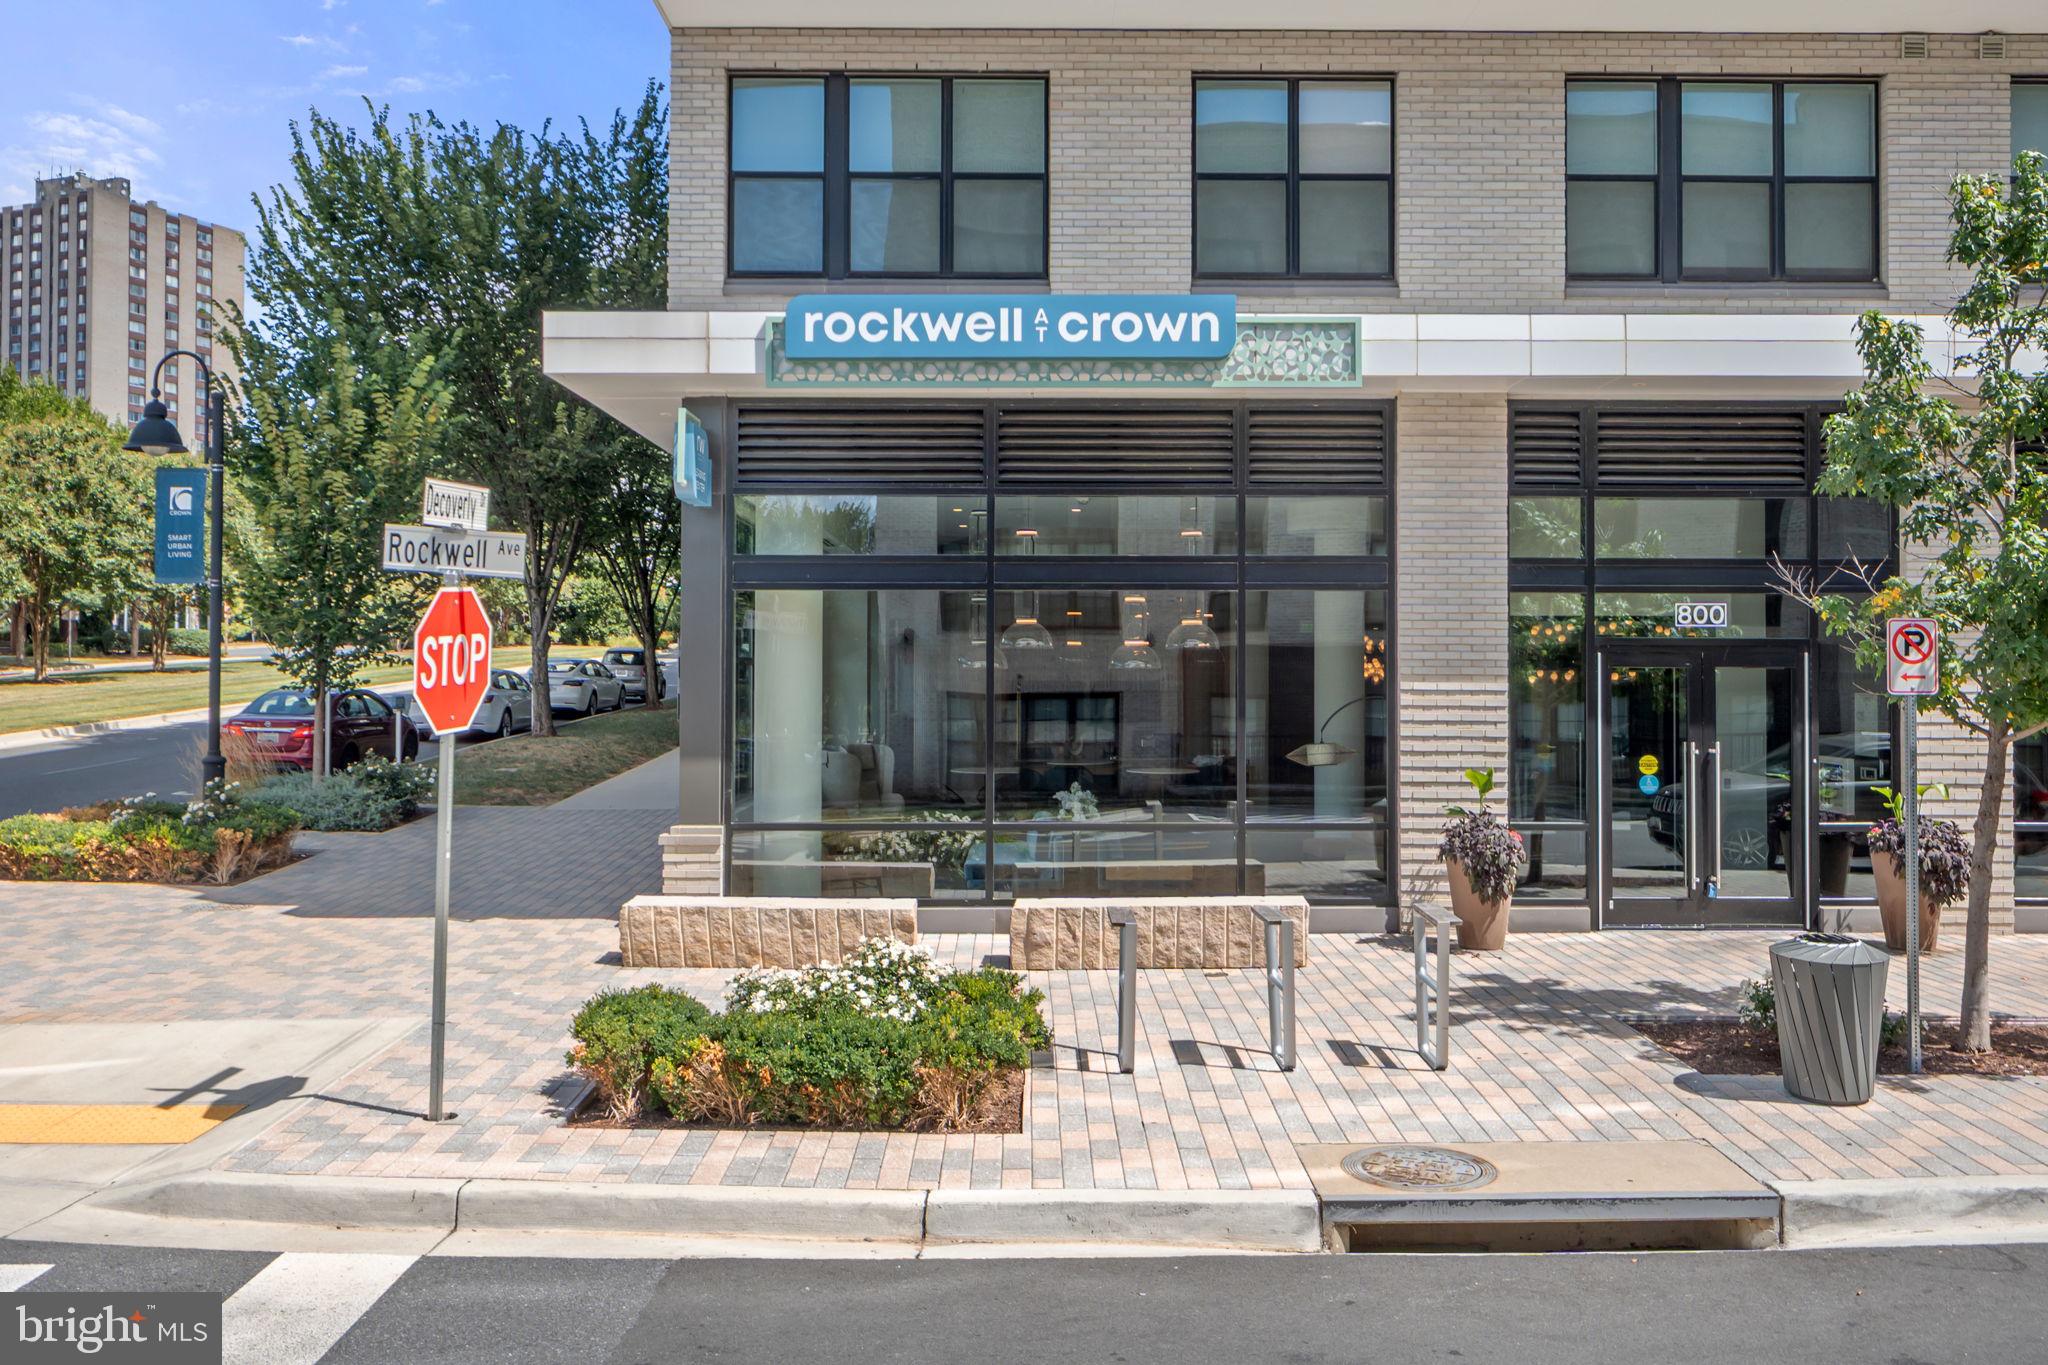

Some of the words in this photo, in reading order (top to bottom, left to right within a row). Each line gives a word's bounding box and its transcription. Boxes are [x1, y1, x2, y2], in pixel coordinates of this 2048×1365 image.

[804, 307, 1022, 342] rockwell
[1058, 311, 1219, 342] crown
[426, 484, 477, 529] Decoverly
[168, 542, 192, 550] URBAN
[388, 533, 487, 569] Rockwell
[497, 540, 520, 557] Ave
[1677, 605, 1724, 625] 800
[420, 633, 486, 690] STOP
